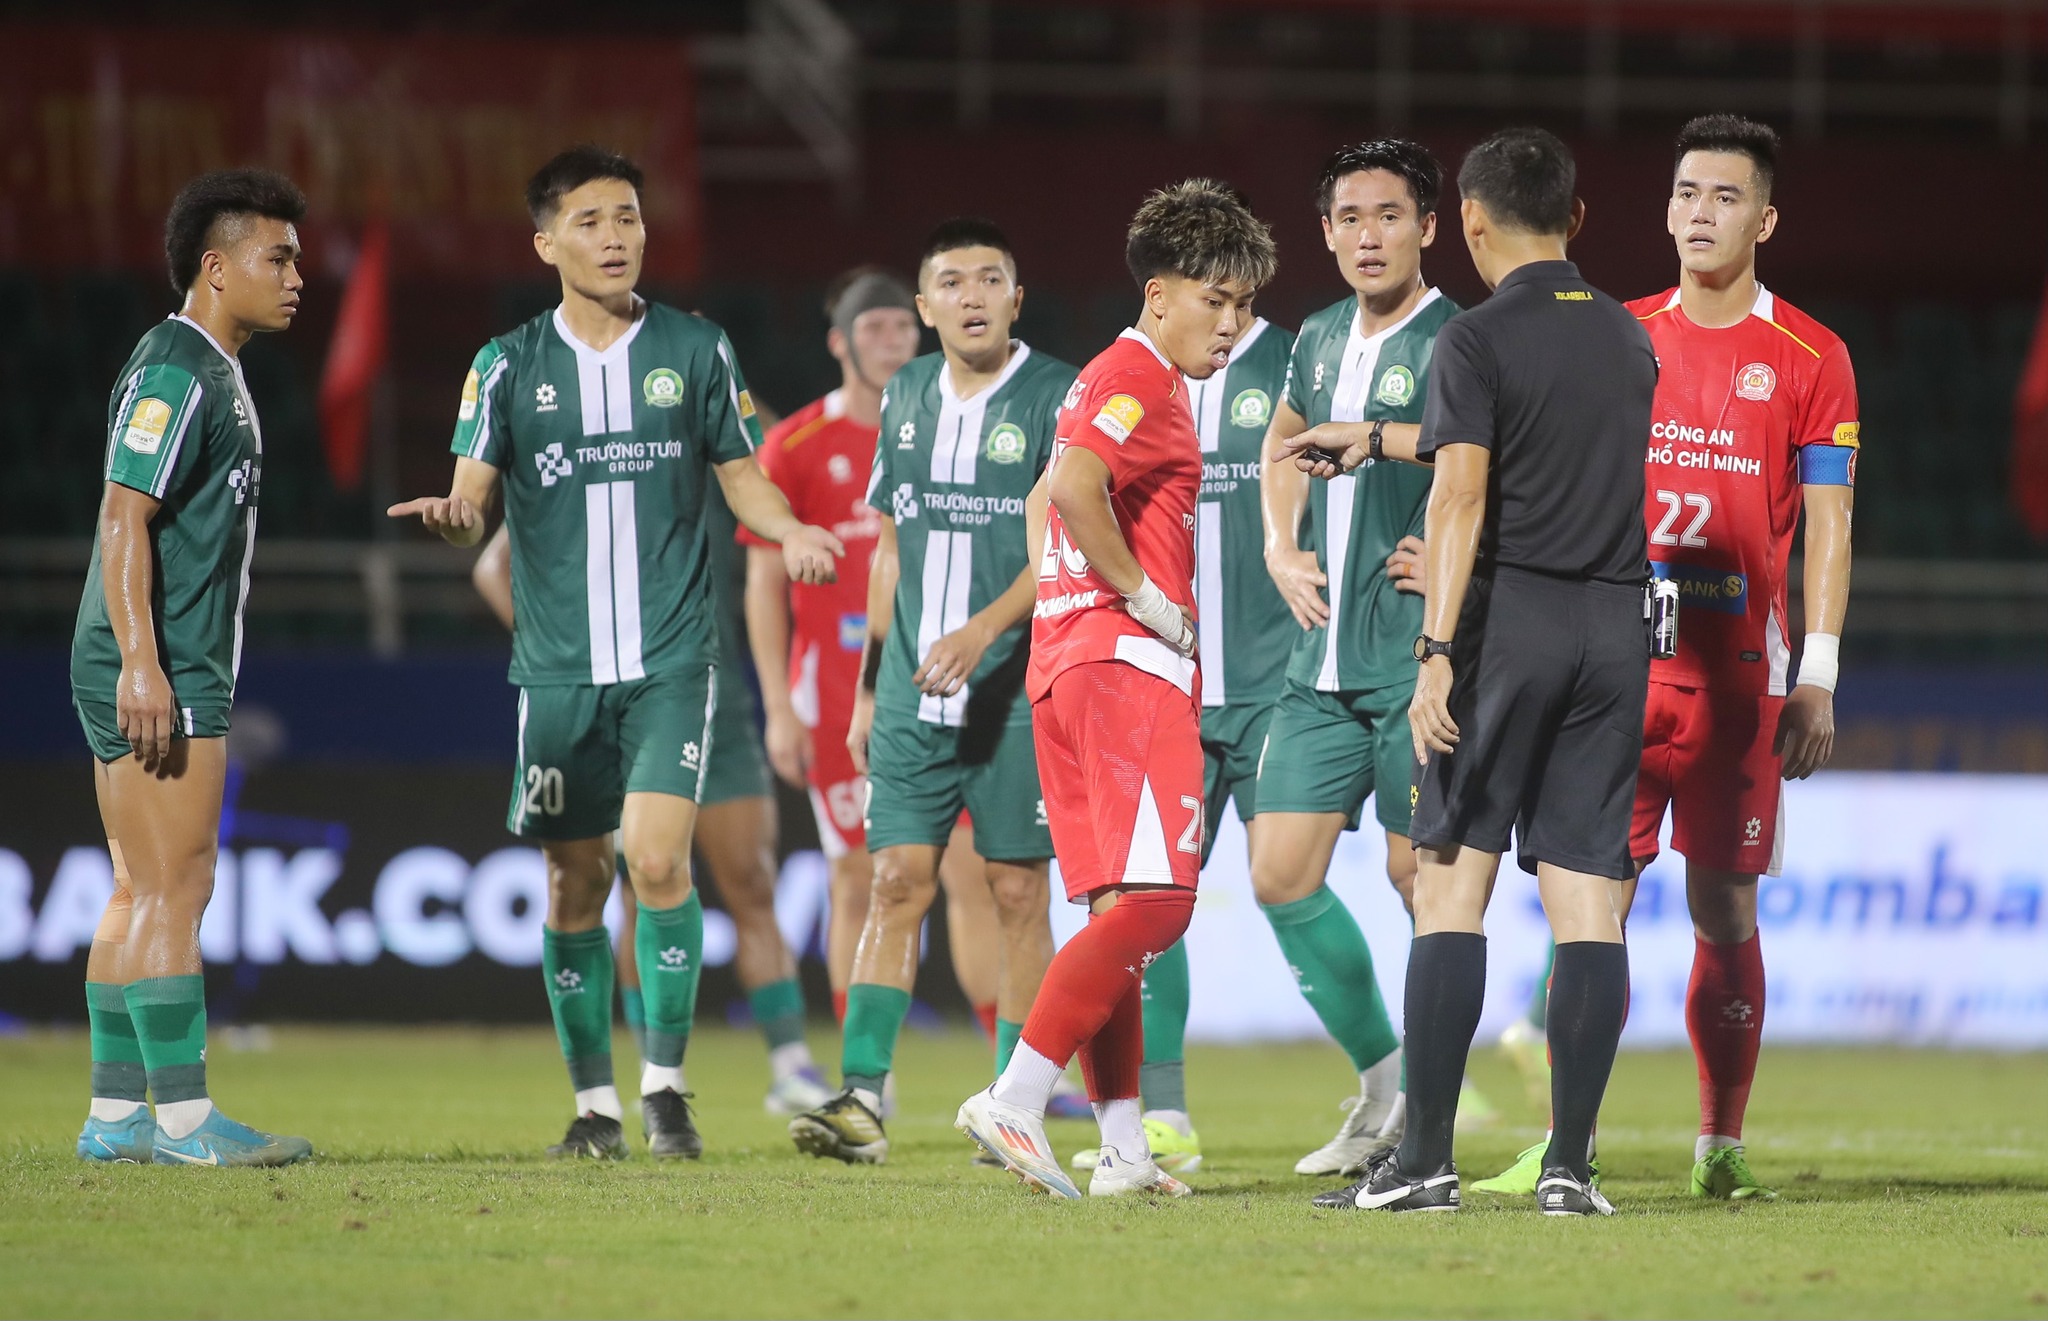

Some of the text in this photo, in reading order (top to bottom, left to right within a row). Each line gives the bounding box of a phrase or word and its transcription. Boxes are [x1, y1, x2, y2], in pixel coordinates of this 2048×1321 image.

[1651, 419, 1735, 447] CÔNG AN
[575, 441, 646, 464] TRƯỜNG
[1676, 448, 1711, 469] CHÍ
[1713, 453, 1762, 476] MINH
[608, 459, 655, 473] GROUP
[1199, 480, 1239, 494] GROUP
[922, 491, 985, 512] TRƯỜNG
[948, 511, 993, 526] GROUP
[1650, 489, 1712, 549] 22
[1674, 578, 1721, 599] ANK
[525, 764, 565, 817] 20
[1176, 794, 1206, 855] 2
[1546, 1192, 1566, 1203] NIKE
